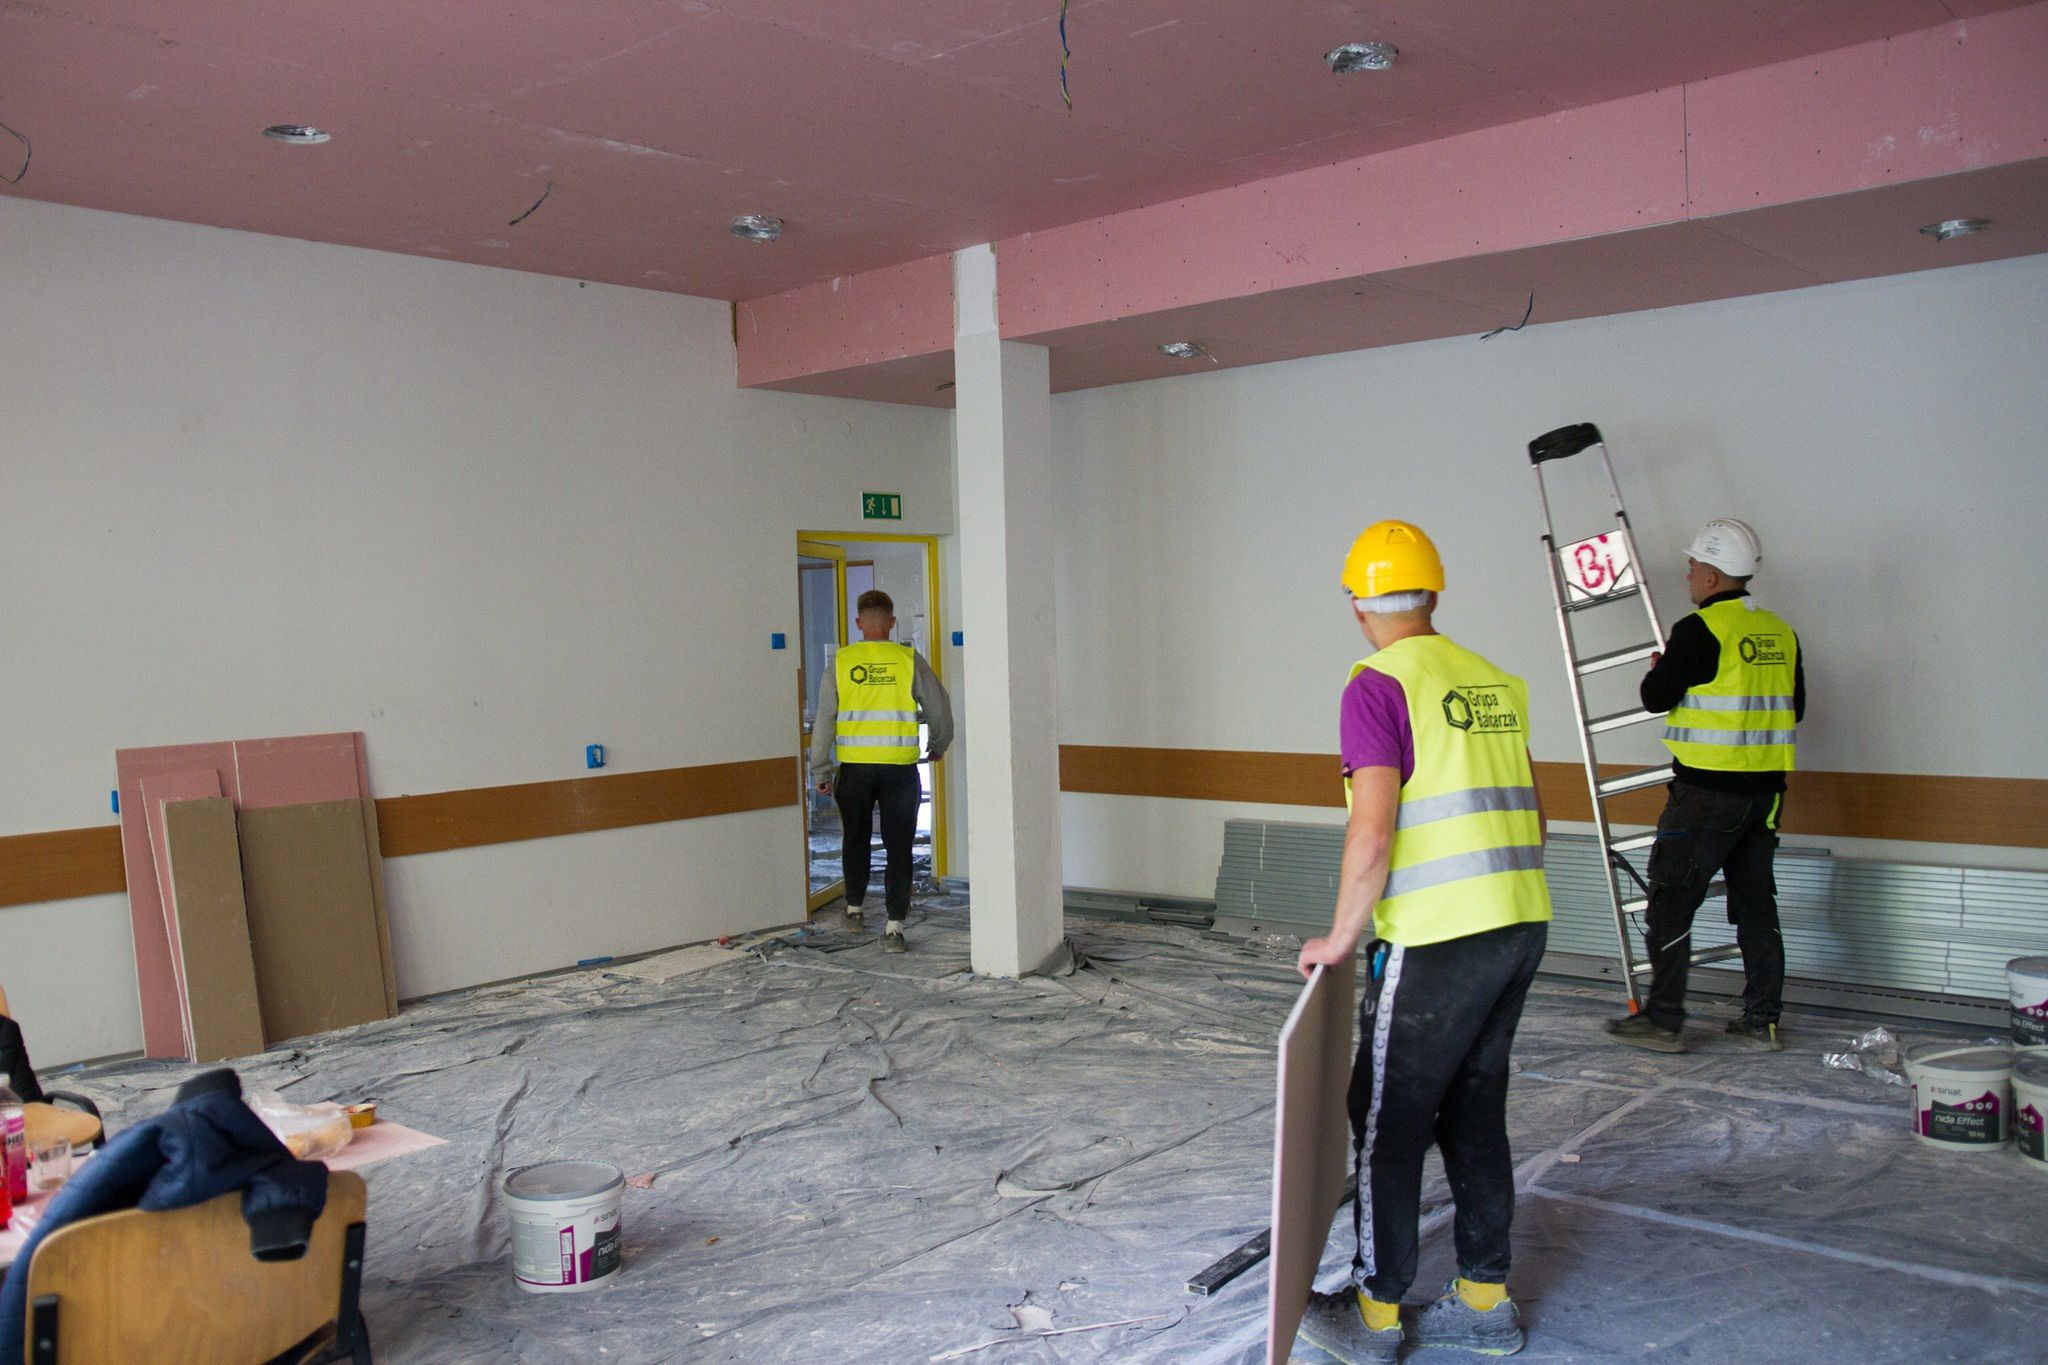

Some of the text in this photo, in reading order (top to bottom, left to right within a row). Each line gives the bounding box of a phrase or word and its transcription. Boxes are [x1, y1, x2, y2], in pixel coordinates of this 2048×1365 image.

[868, 665, 887, 675] Grupa
[868, 674, 896, 683] Balcerzak
[1467, 690, 1499, 710] Grupa
[1474, 709, 1519, 728] Balcerzak
[1935, 1114, 1985, 1126] nida Effect
